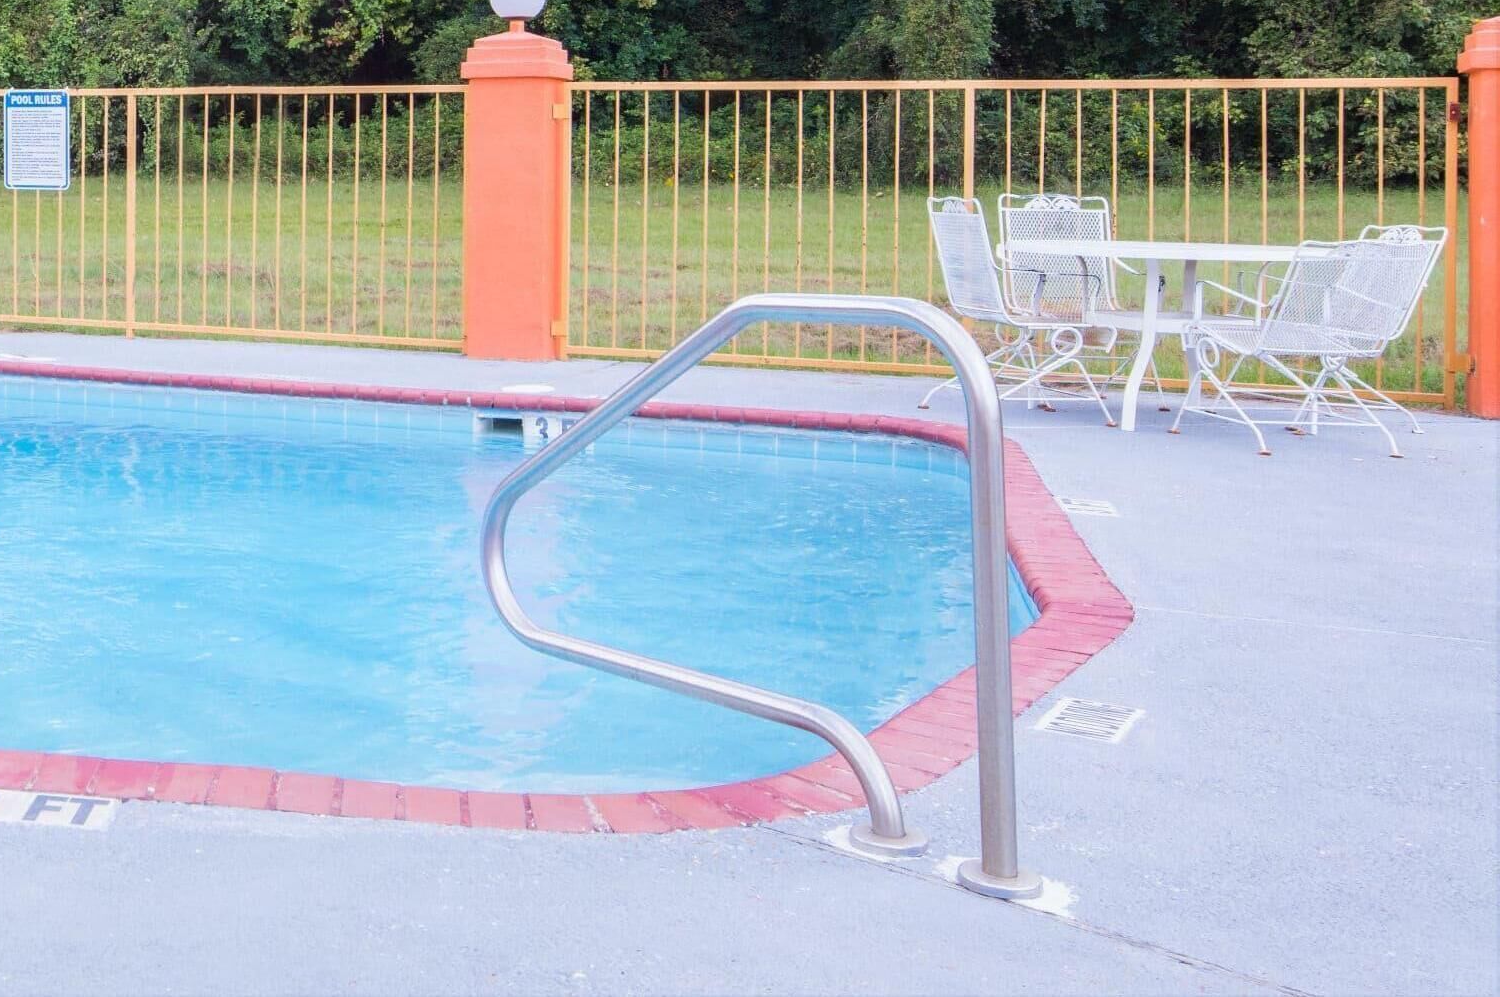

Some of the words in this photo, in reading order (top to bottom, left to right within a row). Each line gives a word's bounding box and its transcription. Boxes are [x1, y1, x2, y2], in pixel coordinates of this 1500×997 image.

[11, 95, 33, 105] POOL
[34, 95, 62, 105] RULES
[535, 417, 548, 439] 3
[22, 794, 111, 825] FT
